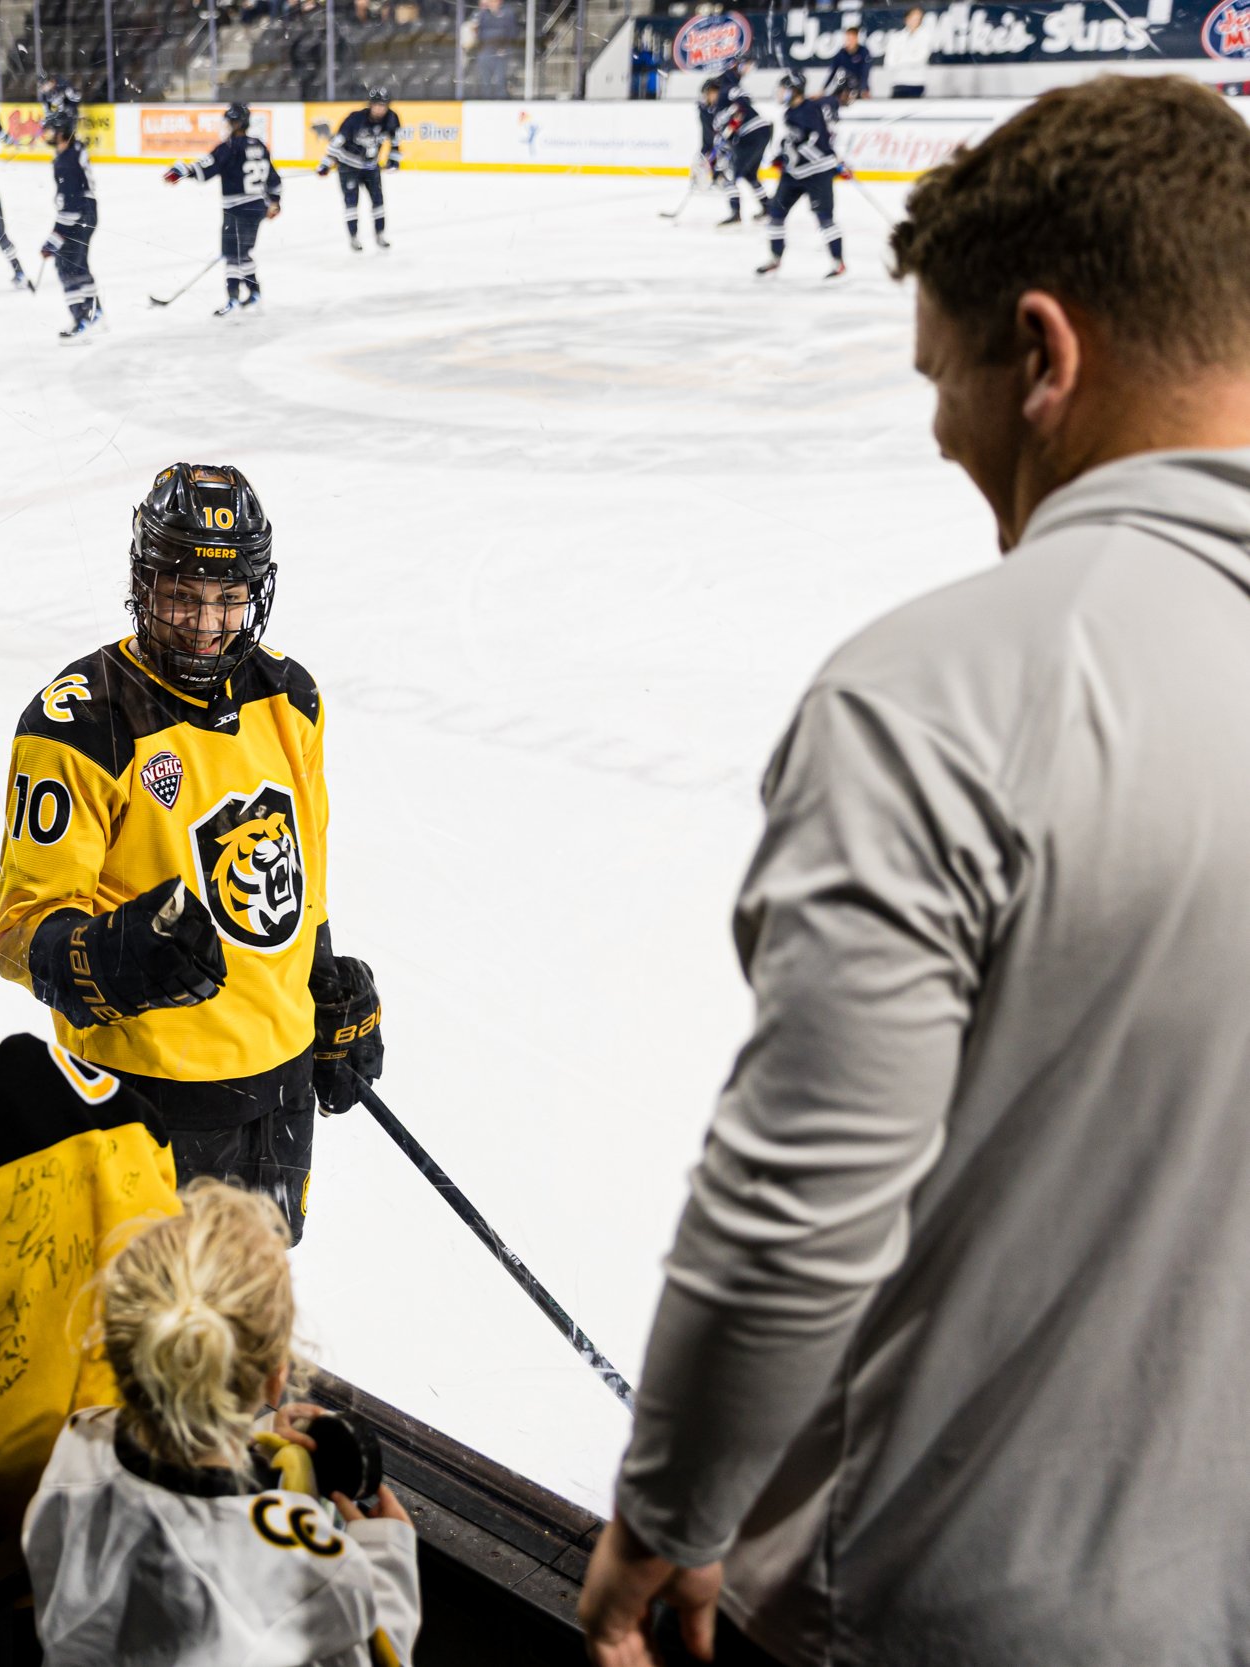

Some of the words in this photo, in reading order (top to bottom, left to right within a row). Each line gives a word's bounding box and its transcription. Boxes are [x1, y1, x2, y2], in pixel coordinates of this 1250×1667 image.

[202, 506, 235, 529] 10
[194, 546, 237, 559] TIGERS
[141, 758, 183, 786] NCHC
[11, 772, 73, 846] 10
